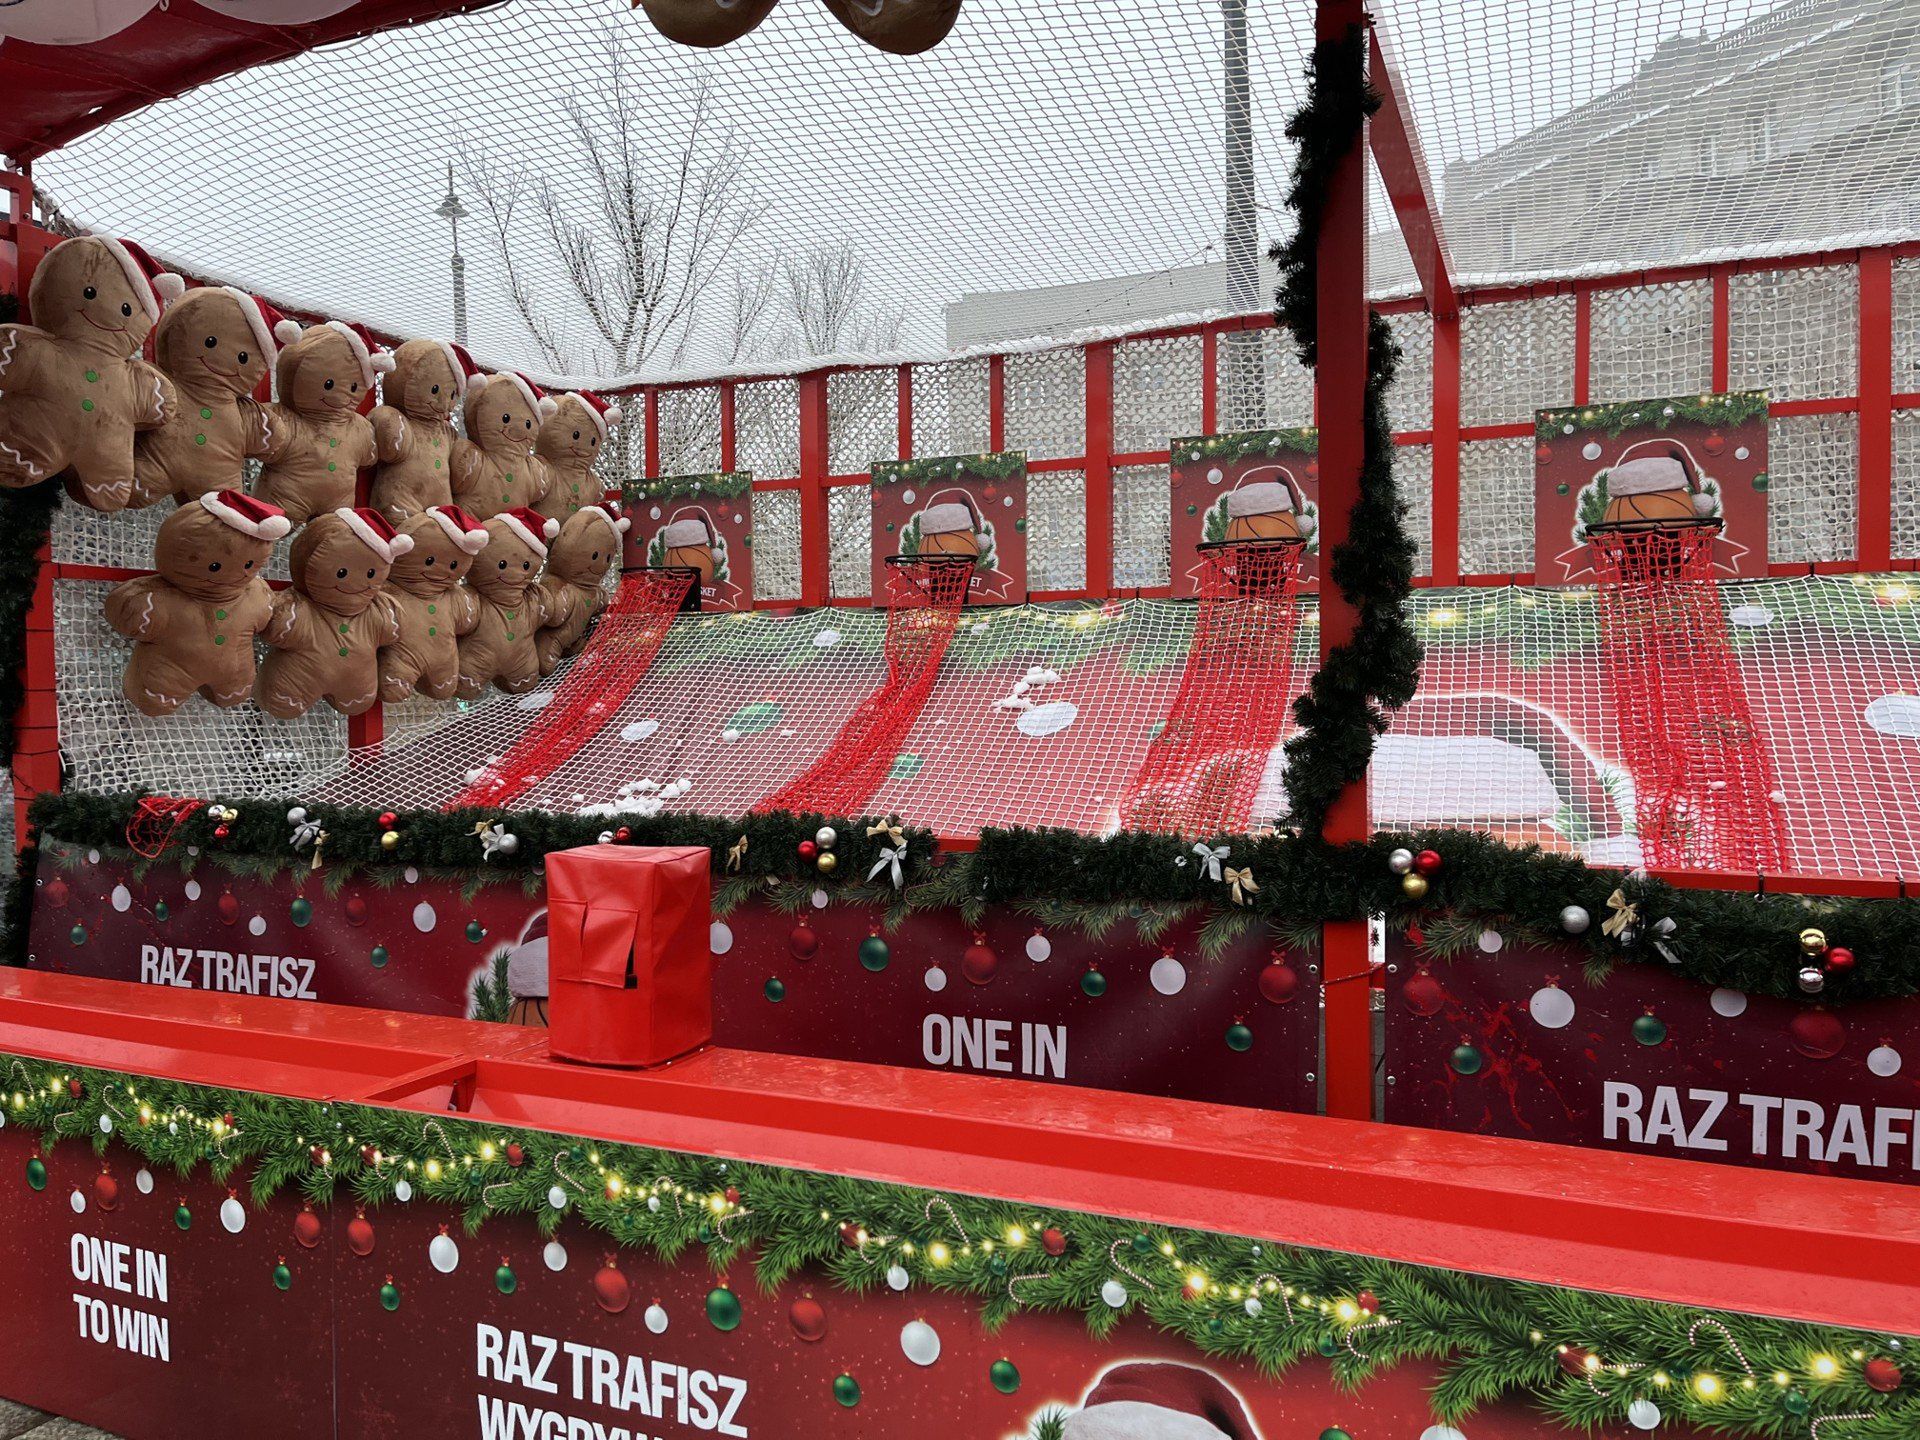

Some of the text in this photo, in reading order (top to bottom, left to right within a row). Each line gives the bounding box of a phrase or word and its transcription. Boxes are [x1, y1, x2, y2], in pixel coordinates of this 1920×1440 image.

[141, 945, 317, 1000] RAZ TRAFISZ
[922, 1013, 1067, 1079] ONE IN
[1603, 1081, 1729, 1152] RAZ
[70, 1232, 168, 1303] ONE IN
[72, 1293, 170, 1362] TO WIN
[476, 1322, 748, 1439] RAZ TRAFISZ
